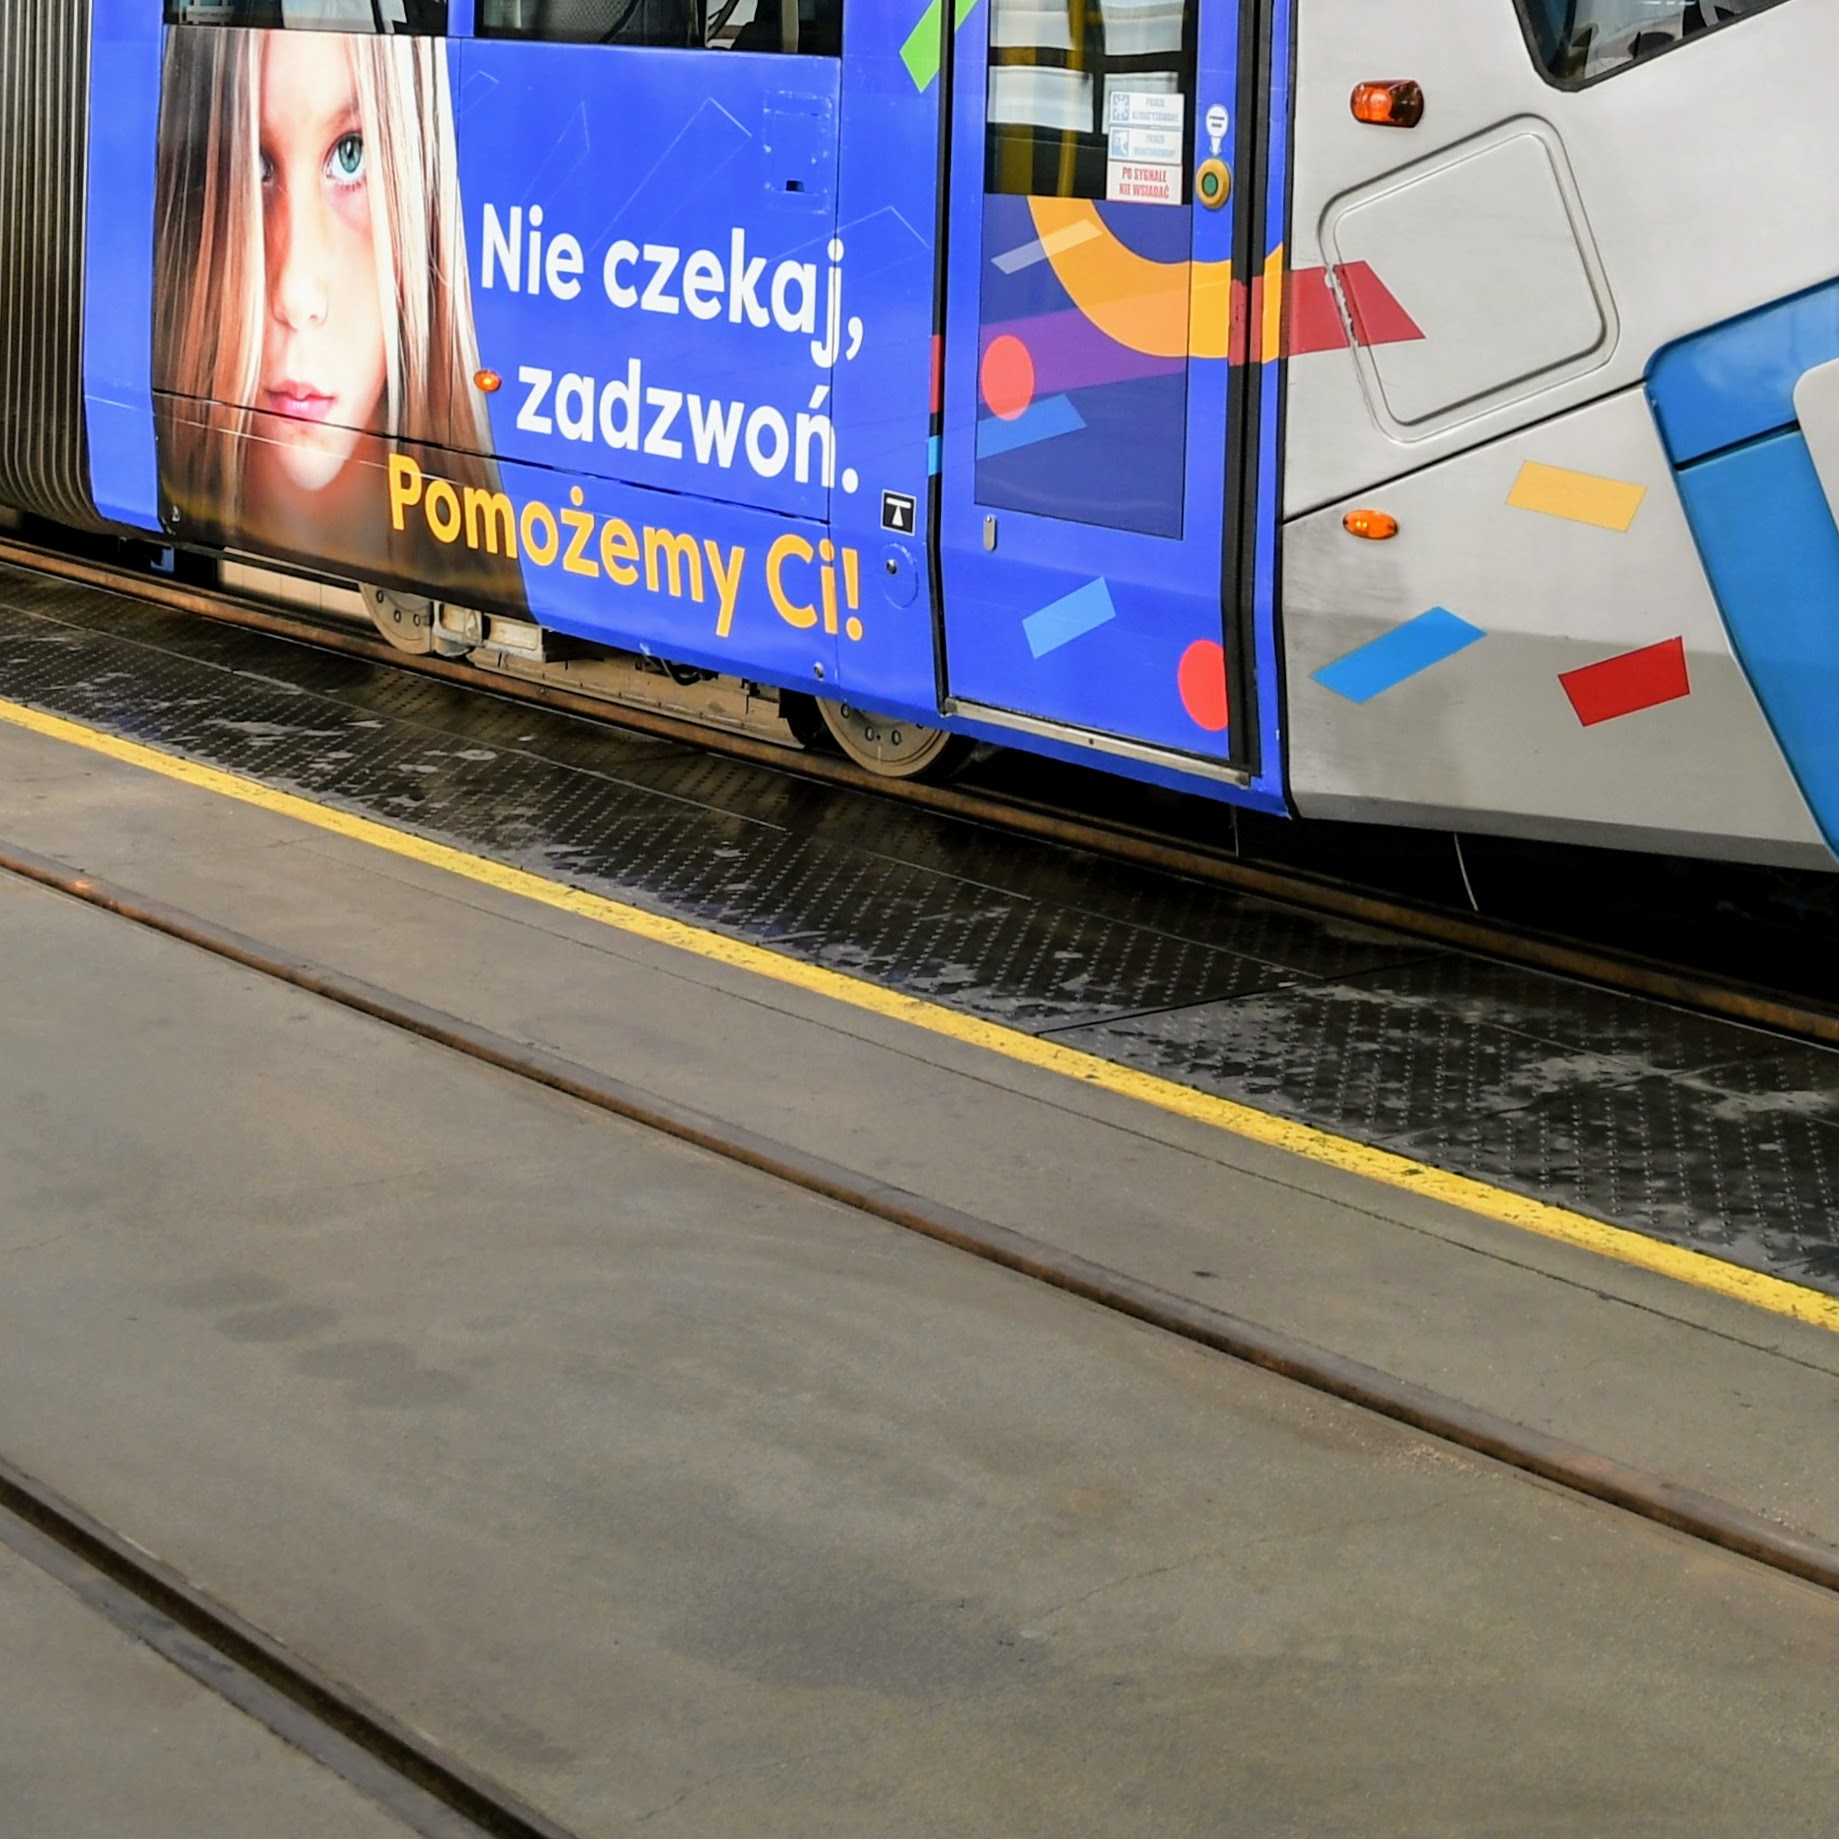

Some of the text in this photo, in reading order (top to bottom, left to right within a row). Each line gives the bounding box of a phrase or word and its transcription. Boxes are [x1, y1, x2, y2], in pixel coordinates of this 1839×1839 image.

[481, 203, 865, 368] Nie czekaj,
[516, 358, 860, 493] zadzwoń.
[388, 454, 864, 642] Pomożemy Ci!
